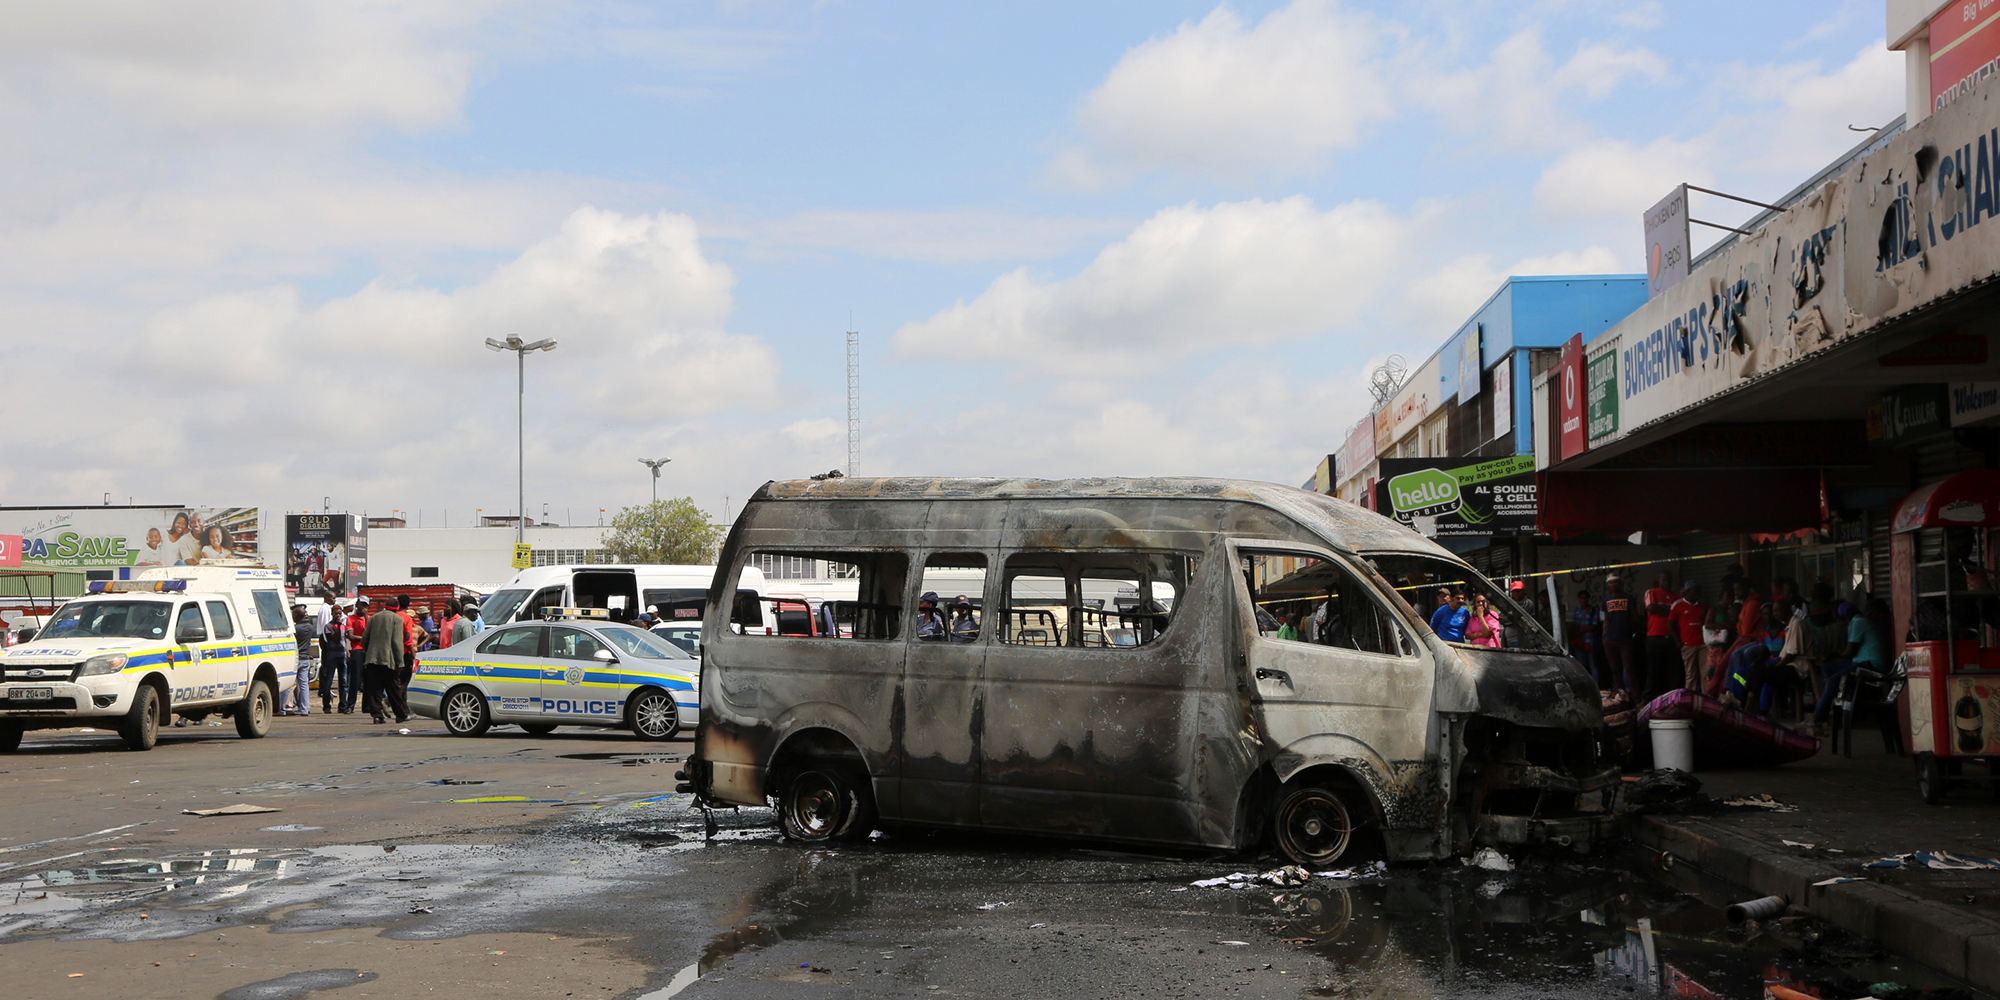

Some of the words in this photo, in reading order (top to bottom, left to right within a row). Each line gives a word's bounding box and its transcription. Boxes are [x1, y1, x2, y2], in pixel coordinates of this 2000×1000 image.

[1964, 3, 1977, 21] Big
[1459, 475, 1474, 483] Pay
[1488, 468, 1503, 477] you
[1505, 466, 1516, 474] go
[1518, 461, 1535, 470] SIM
[1476, 458, 1514, 472] Low-cost
[1396, 481, 1452, 507] hello
[1474, 486, 1490, 494] AL
[1494, 494, 1504, 502] &
[1507, 494, 1537, 502] CELL
[1401, 502, 1457, 520] MOBILE
[300, 516, 330, 524] GOLD
[174, 685, 216, 702] POLICE
[543, 699, 617, 714] POLICE
